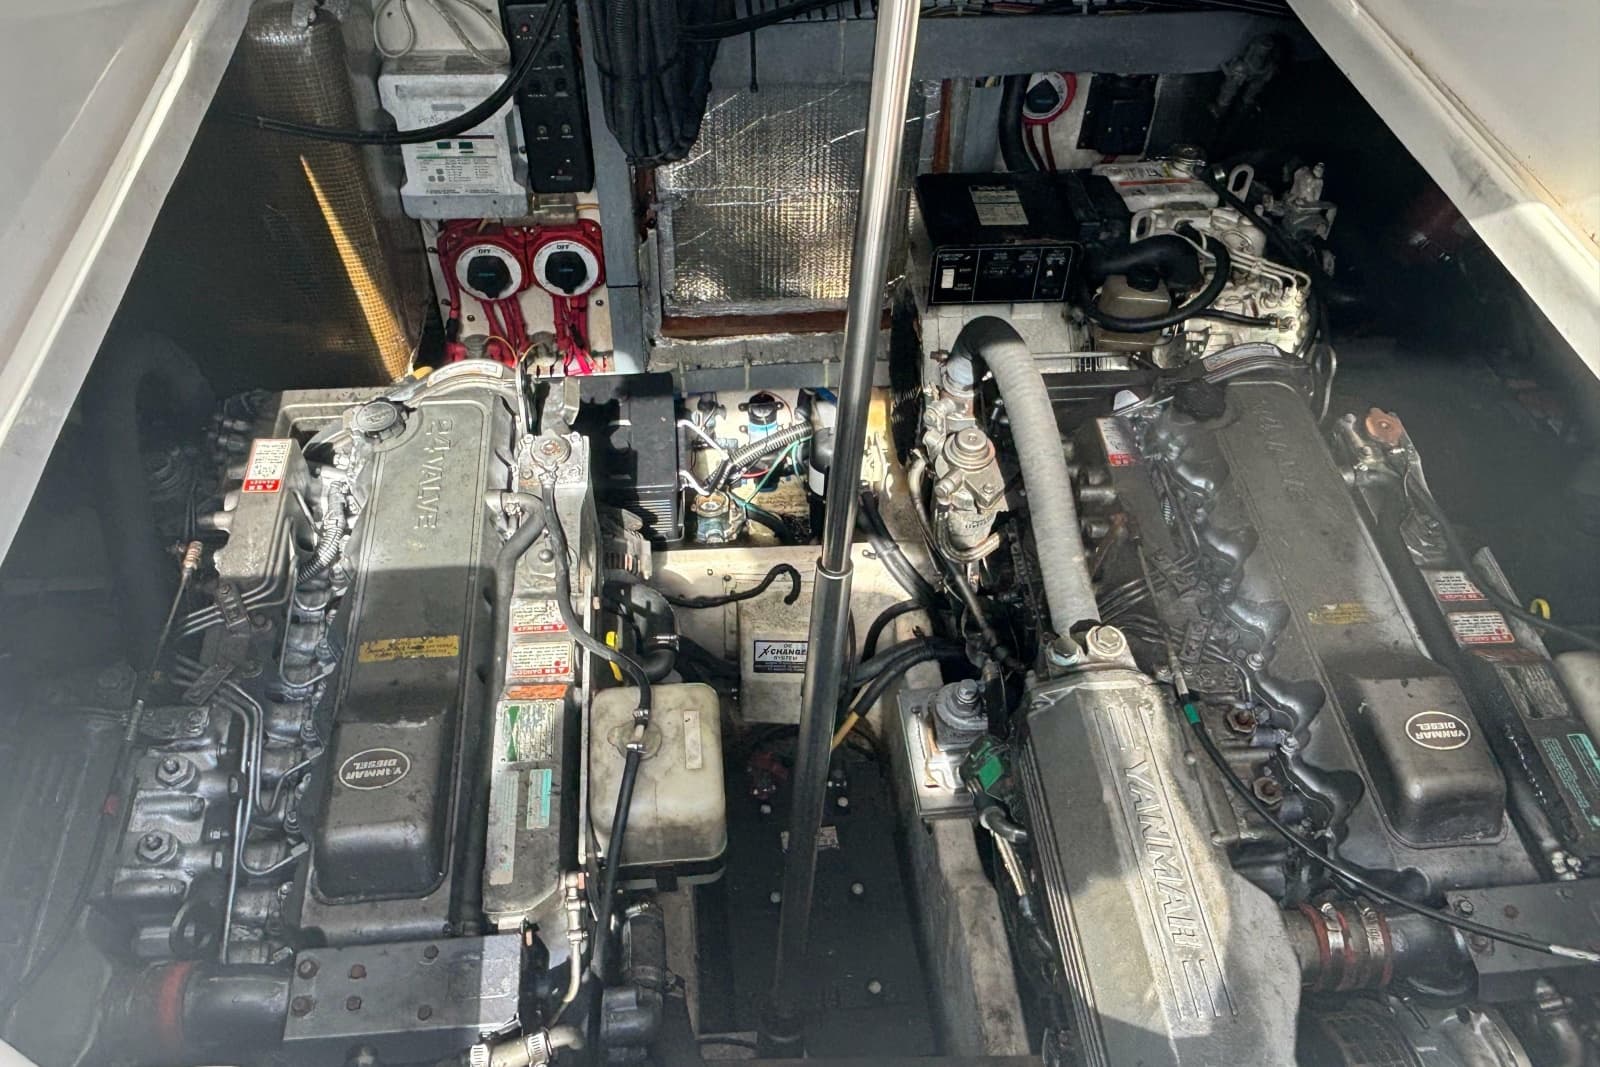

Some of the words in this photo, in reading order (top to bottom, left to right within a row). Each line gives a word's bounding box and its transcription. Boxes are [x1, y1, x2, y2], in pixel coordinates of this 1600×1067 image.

[1415, 721, 1457, 732] DIESEL
[1414, 729, 1466, 740] YANMAR
[353, 758, 397, 770] DIESEL
[345, 767, 402, 780] YANMAR
[1123, 759, 1203, 950] YANMAR
